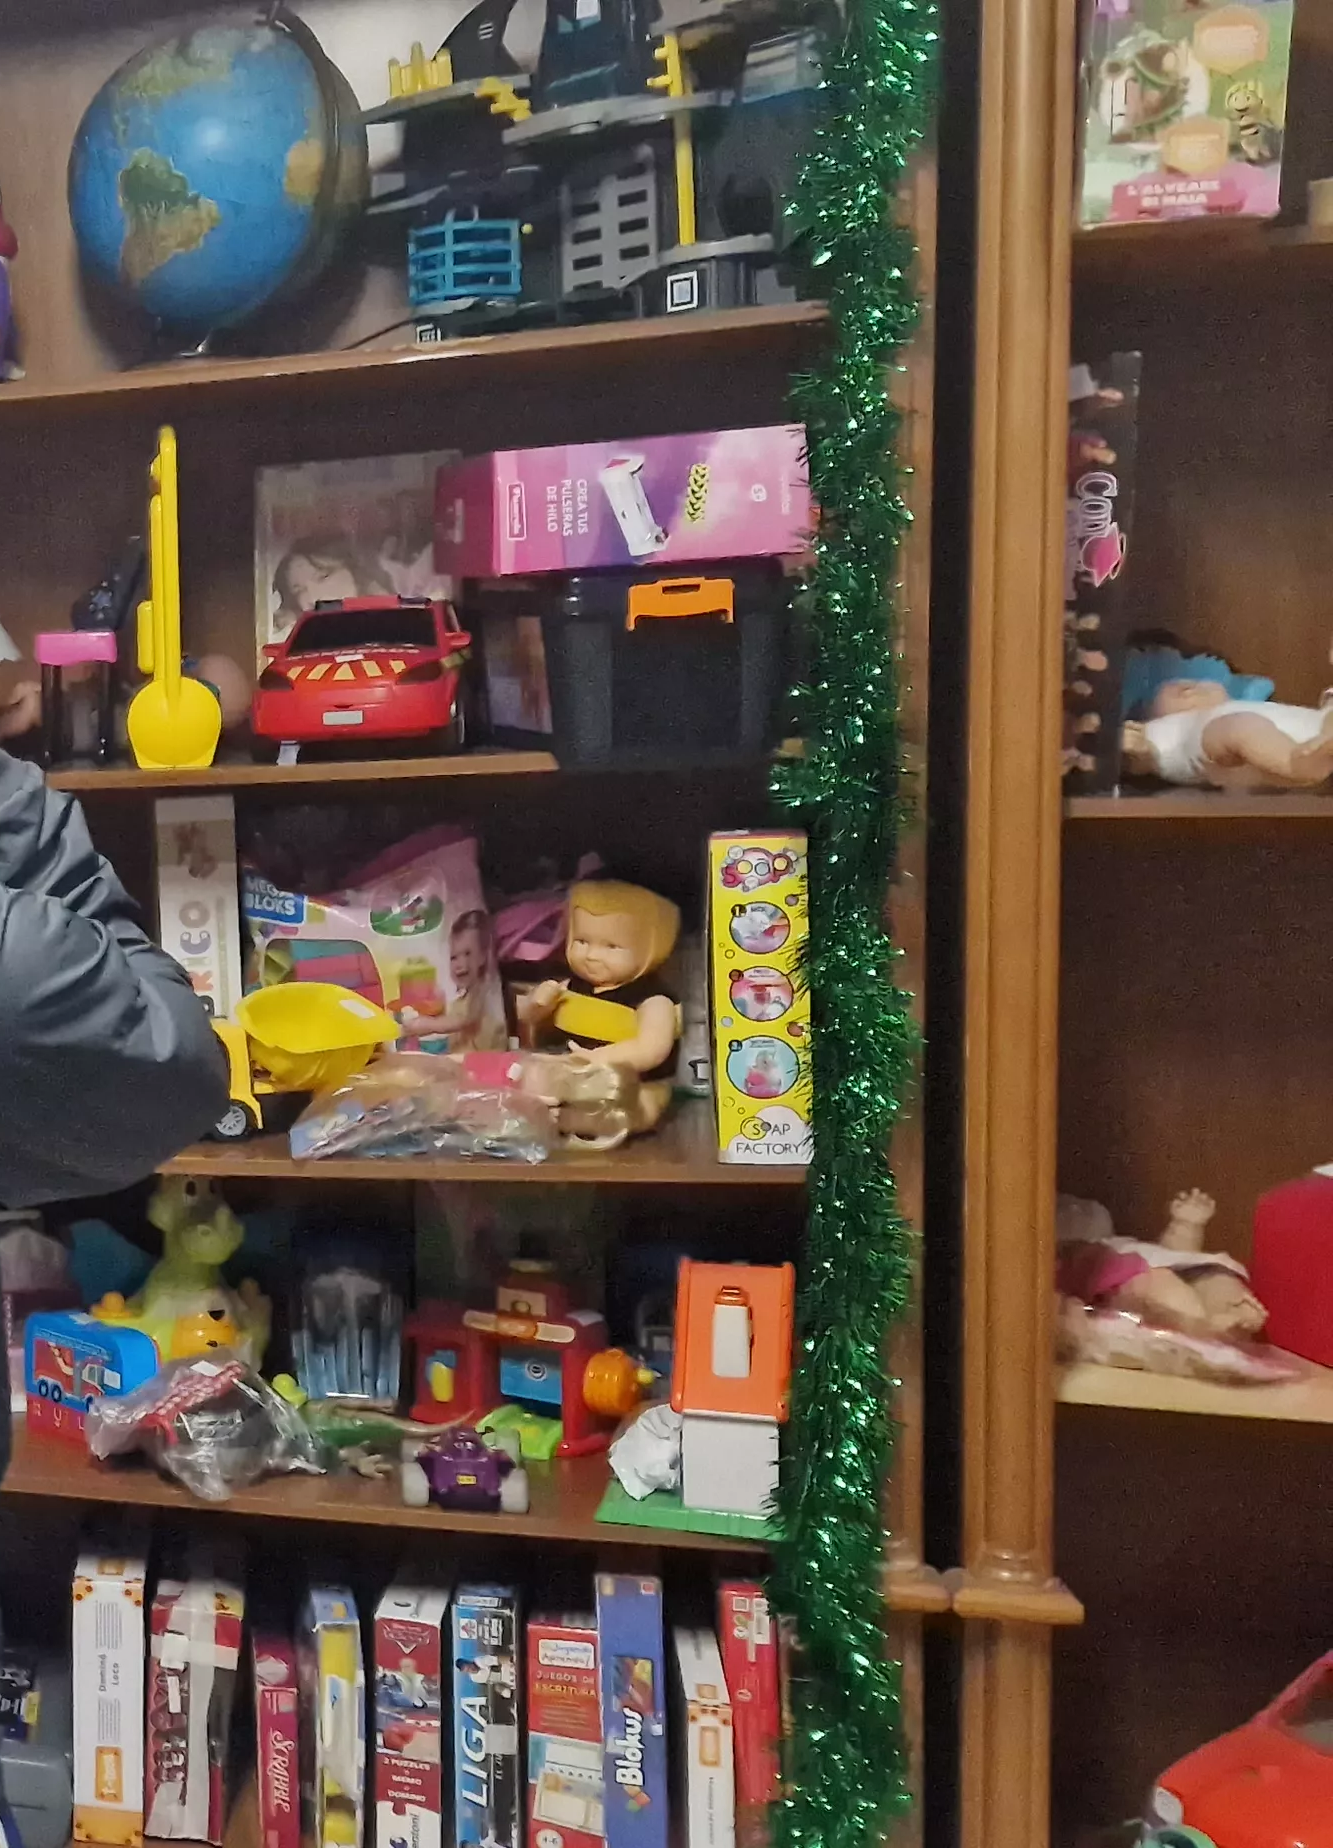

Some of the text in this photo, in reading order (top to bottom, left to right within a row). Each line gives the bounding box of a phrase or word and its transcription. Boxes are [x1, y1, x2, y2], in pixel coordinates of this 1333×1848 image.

[546, 486, 558, 533] DE HILO
[560, 478, 574, 537] PULSERAS
[576, 478, 589, 535] CREA TUS
[736, 1141, 801, 1157] FACTORY
[461, 1696, 489, 1808] LIGA
[614, 1706, 645, 1787] Blokus
